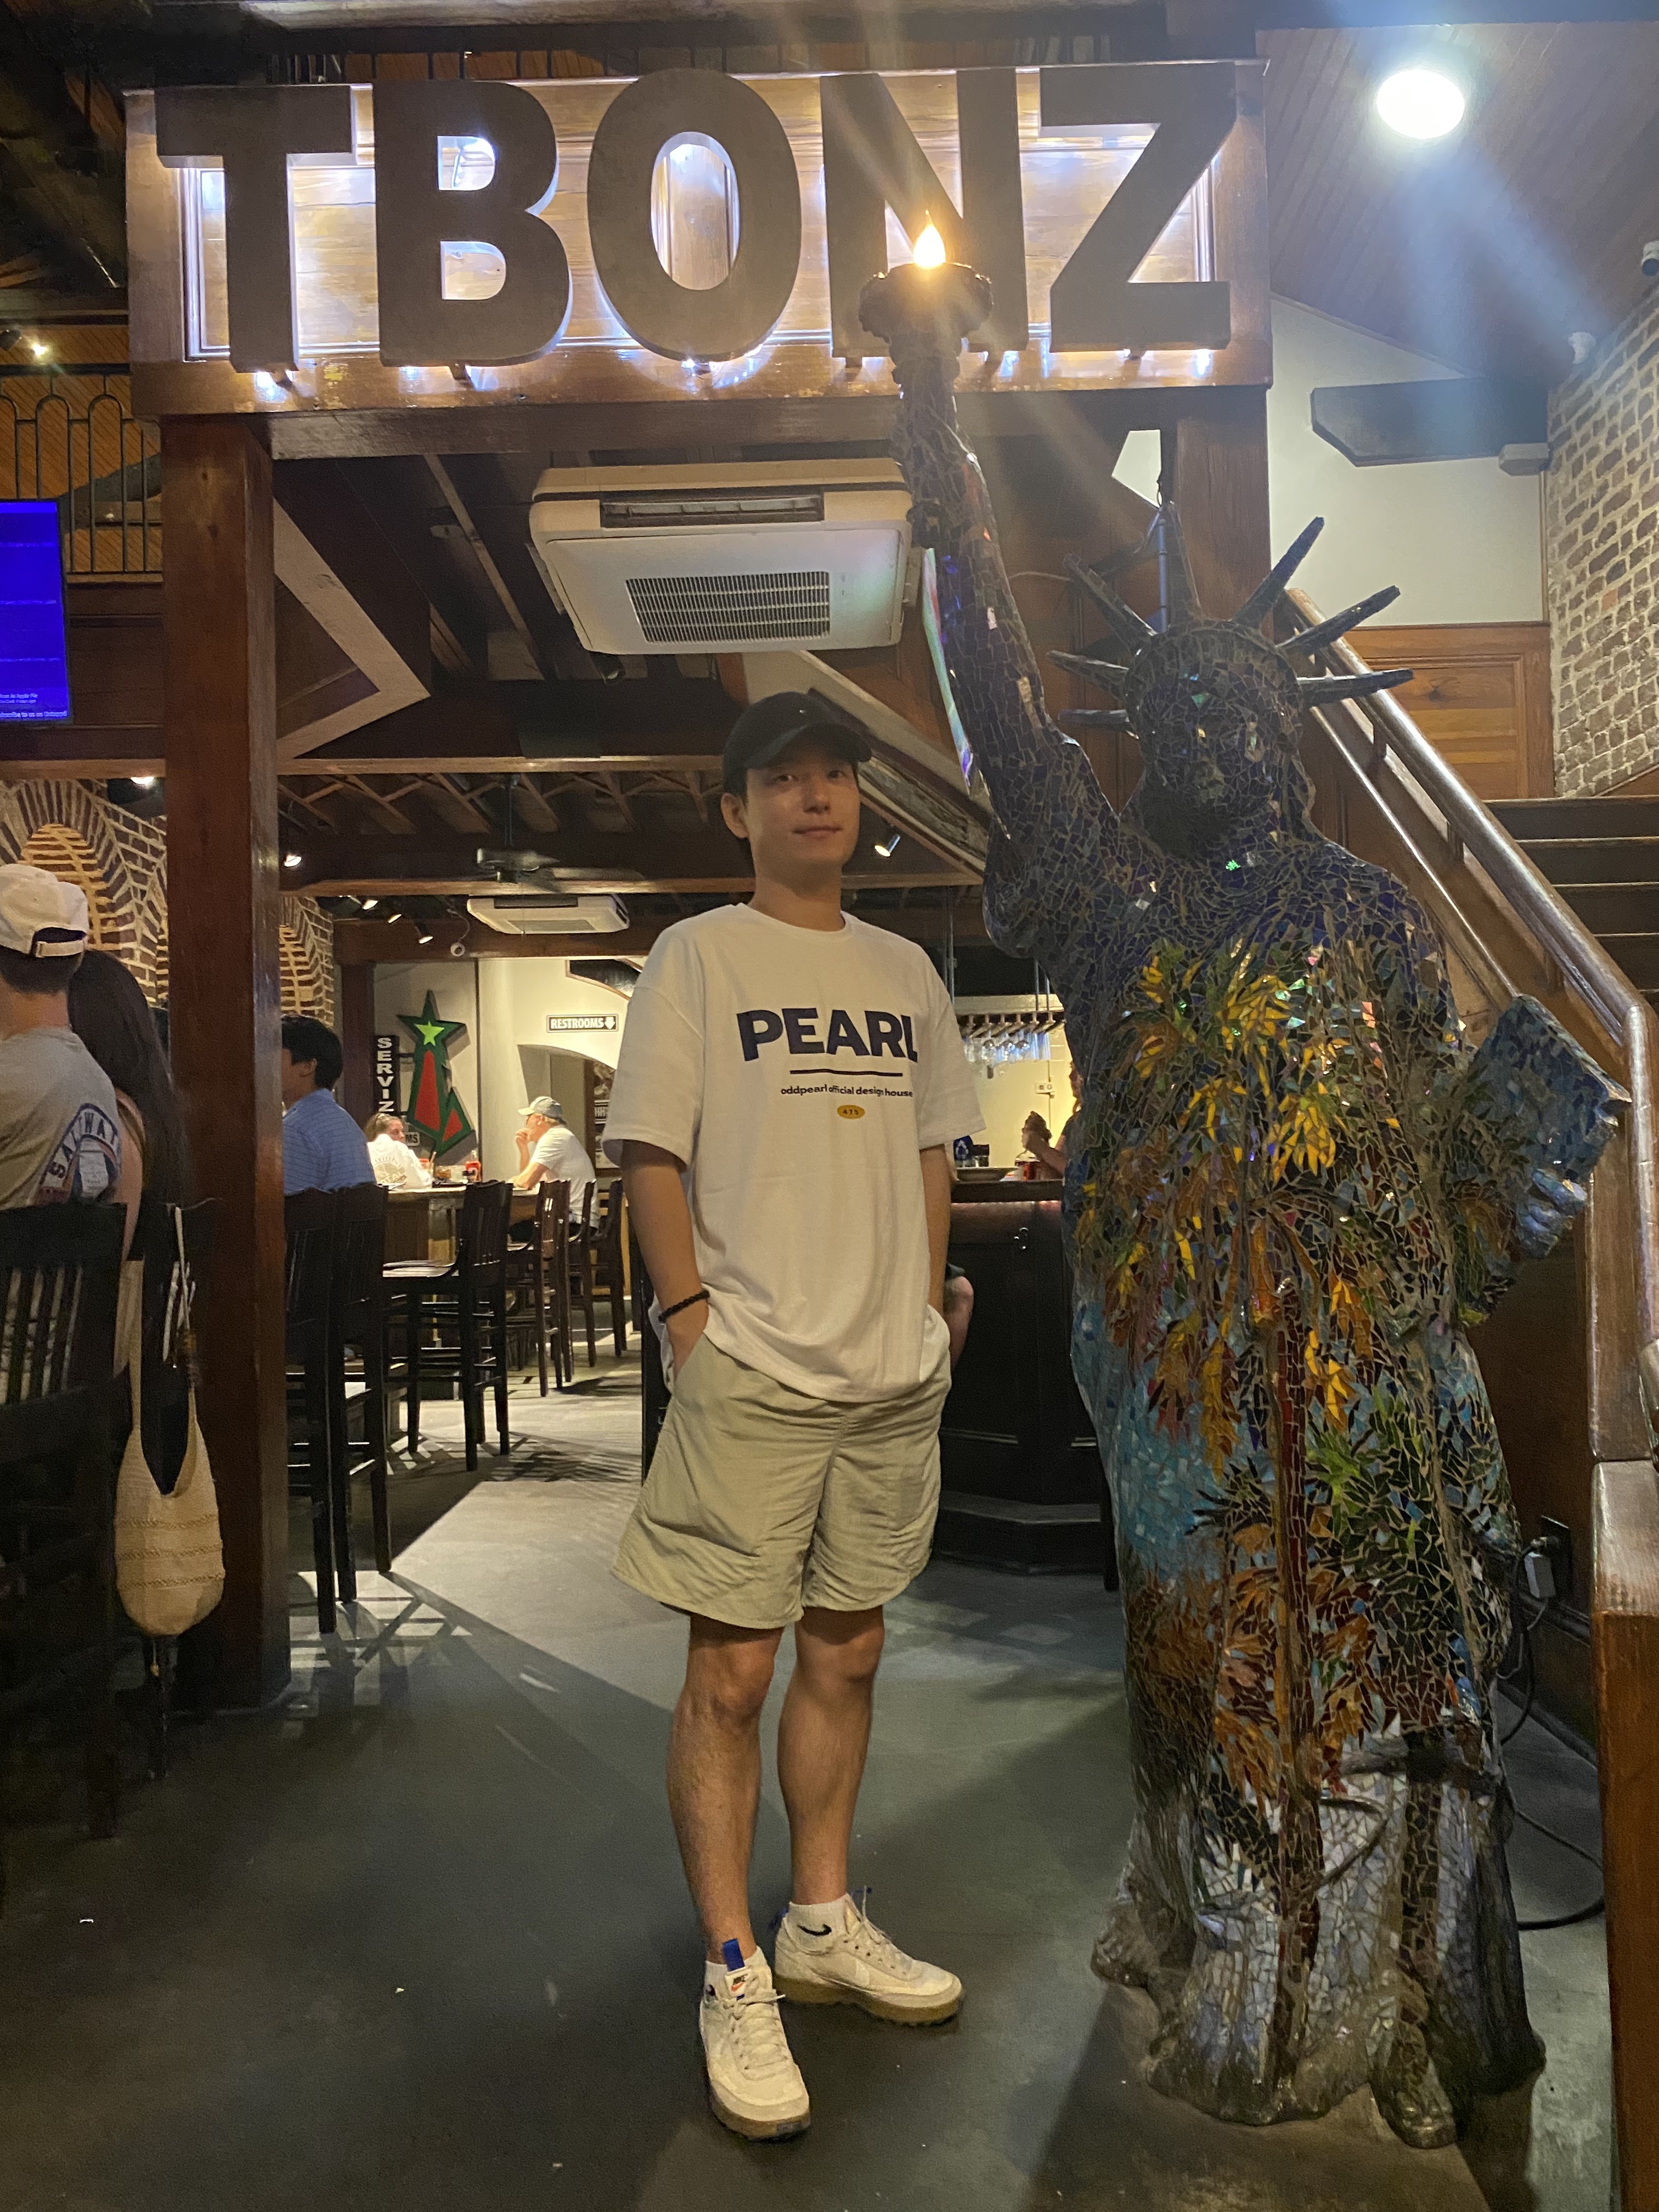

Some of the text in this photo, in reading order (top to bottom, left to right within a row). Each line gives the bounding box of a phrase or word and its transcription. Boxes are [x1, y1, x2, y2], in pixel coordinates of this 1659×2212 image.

[155, 66, 1237, 373] TBONZ
[550, 1017, 605, 1029] RESTROOMS
[736, 1008, 918, 1063] PEARL
[781, 1084, 913, 1097] oddpearl official design house
